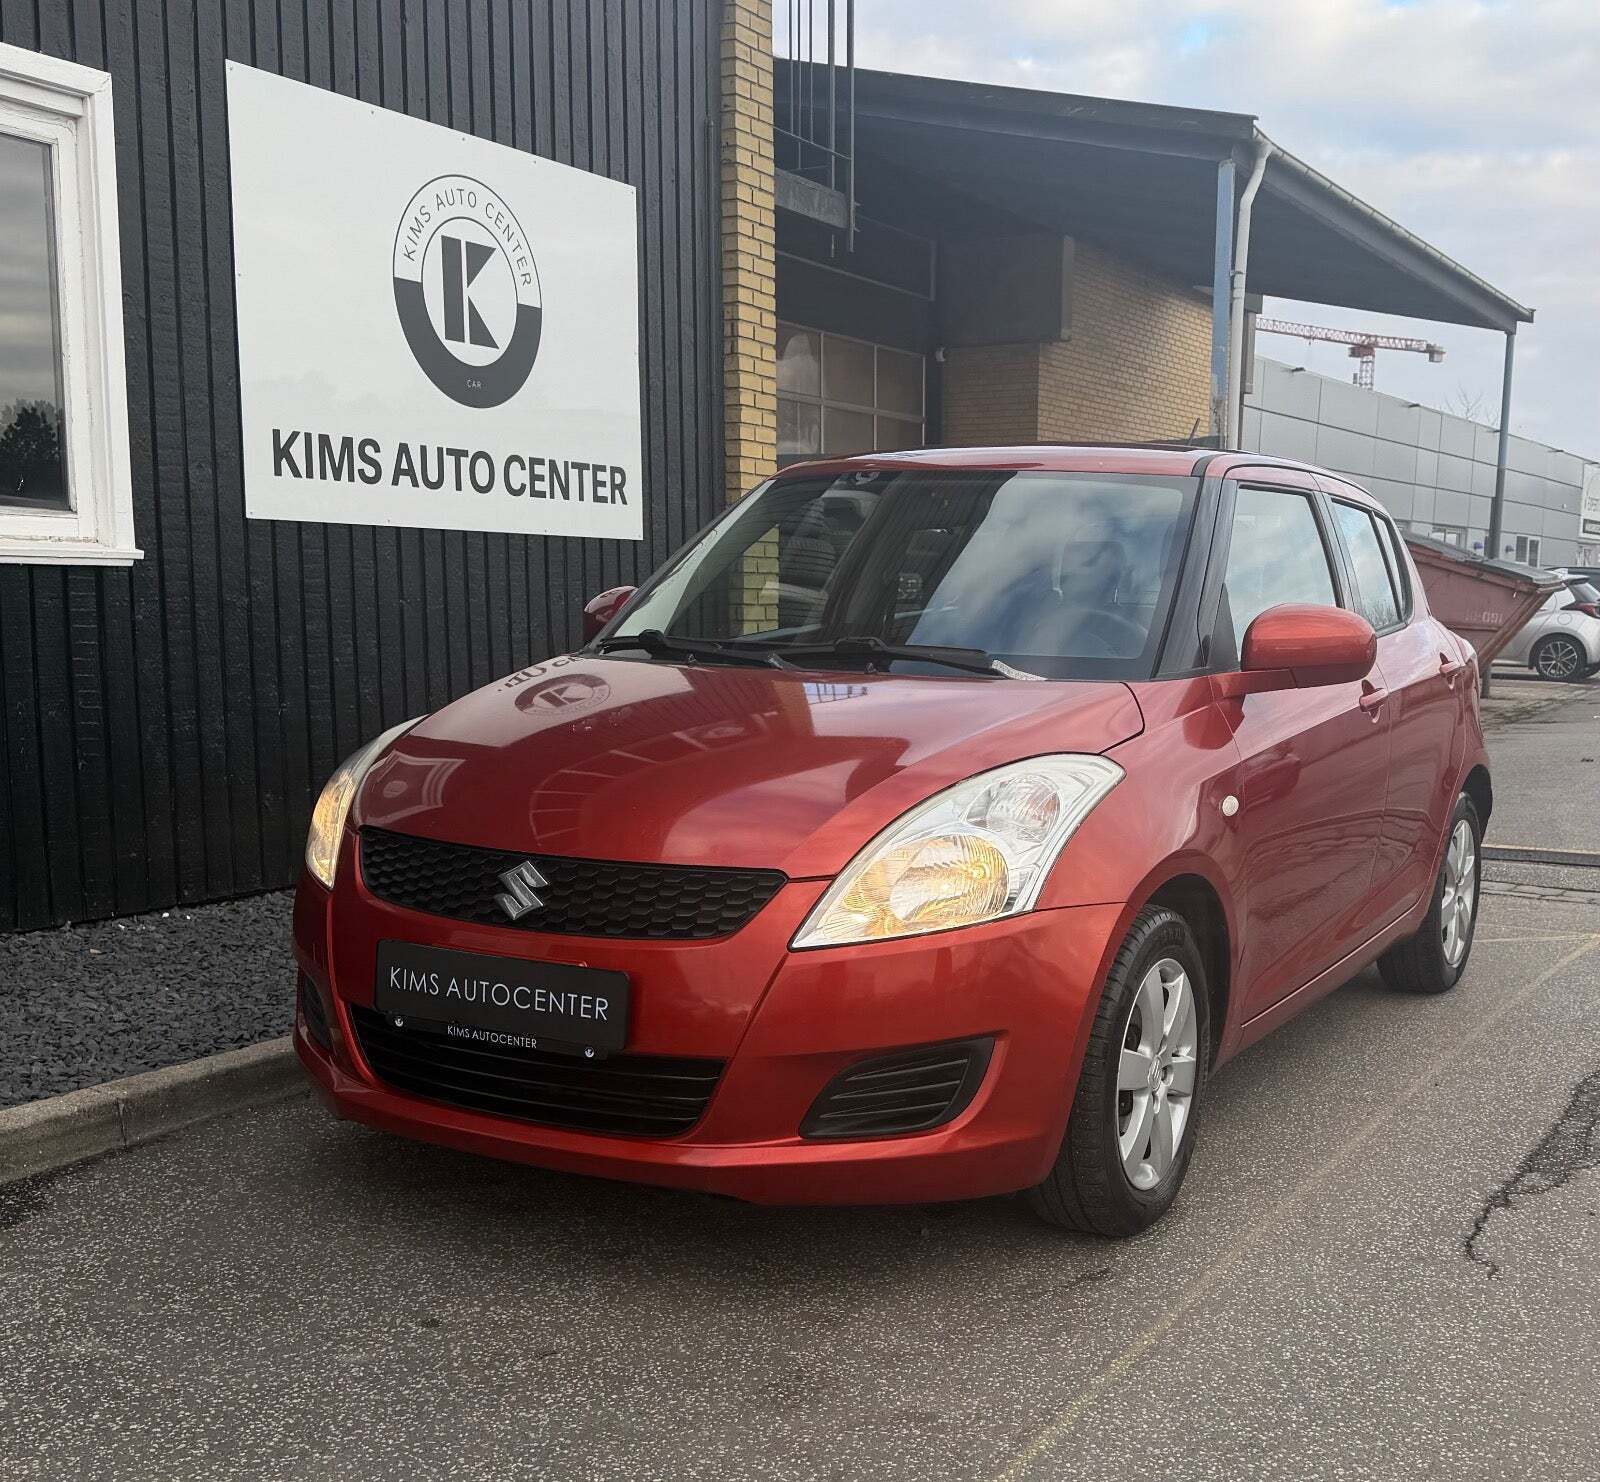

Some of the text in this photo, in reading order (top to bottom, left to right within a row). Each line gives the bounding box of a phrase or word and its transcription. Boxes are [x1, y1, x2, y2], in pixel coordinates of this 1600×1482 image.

[403, 188, 532, 286] KIMS AUTO CENTER
[441, 234, 500, 350] K
[466, 379, 482, 390] CAR
[272, 428, 628, 506] KIMS AUTO CENTER
[389, 965, 610, 1021] KIMS AUTOCENTER
[446, 1024, 538, 1050] KIMS AUTOCENTER
